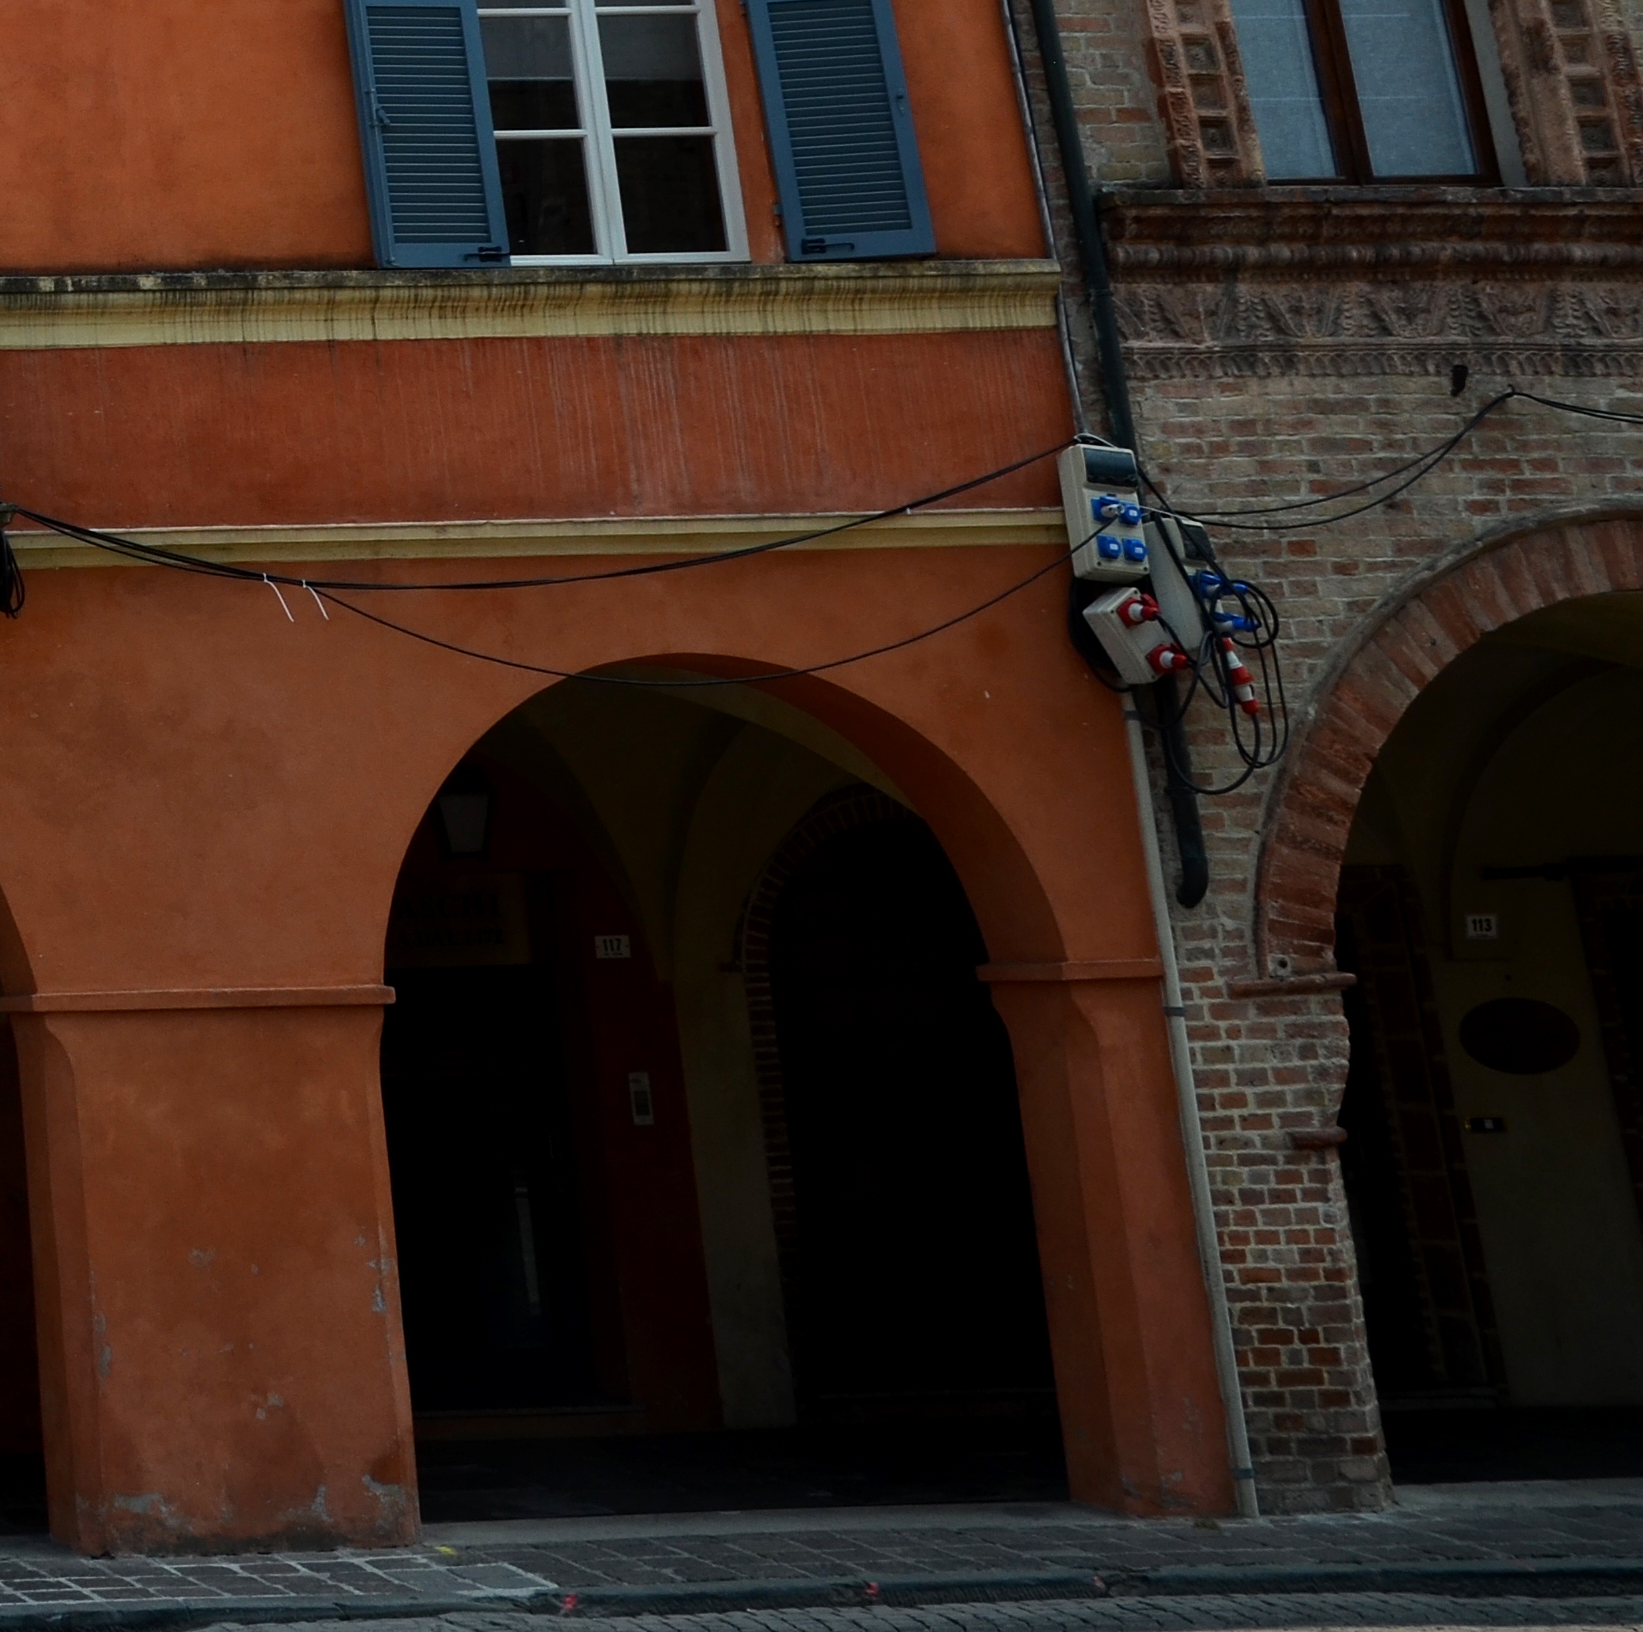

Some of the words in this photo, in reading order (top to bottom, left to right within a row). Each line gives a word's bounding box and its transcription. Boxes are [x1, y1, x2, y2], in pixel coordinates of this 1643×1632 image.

[1472, 918, 1492, 932] 113
[415, 929, 460, 947] DAL
[464, 927, 504, 945] 1472
[603, 938, 621, 952] 117
